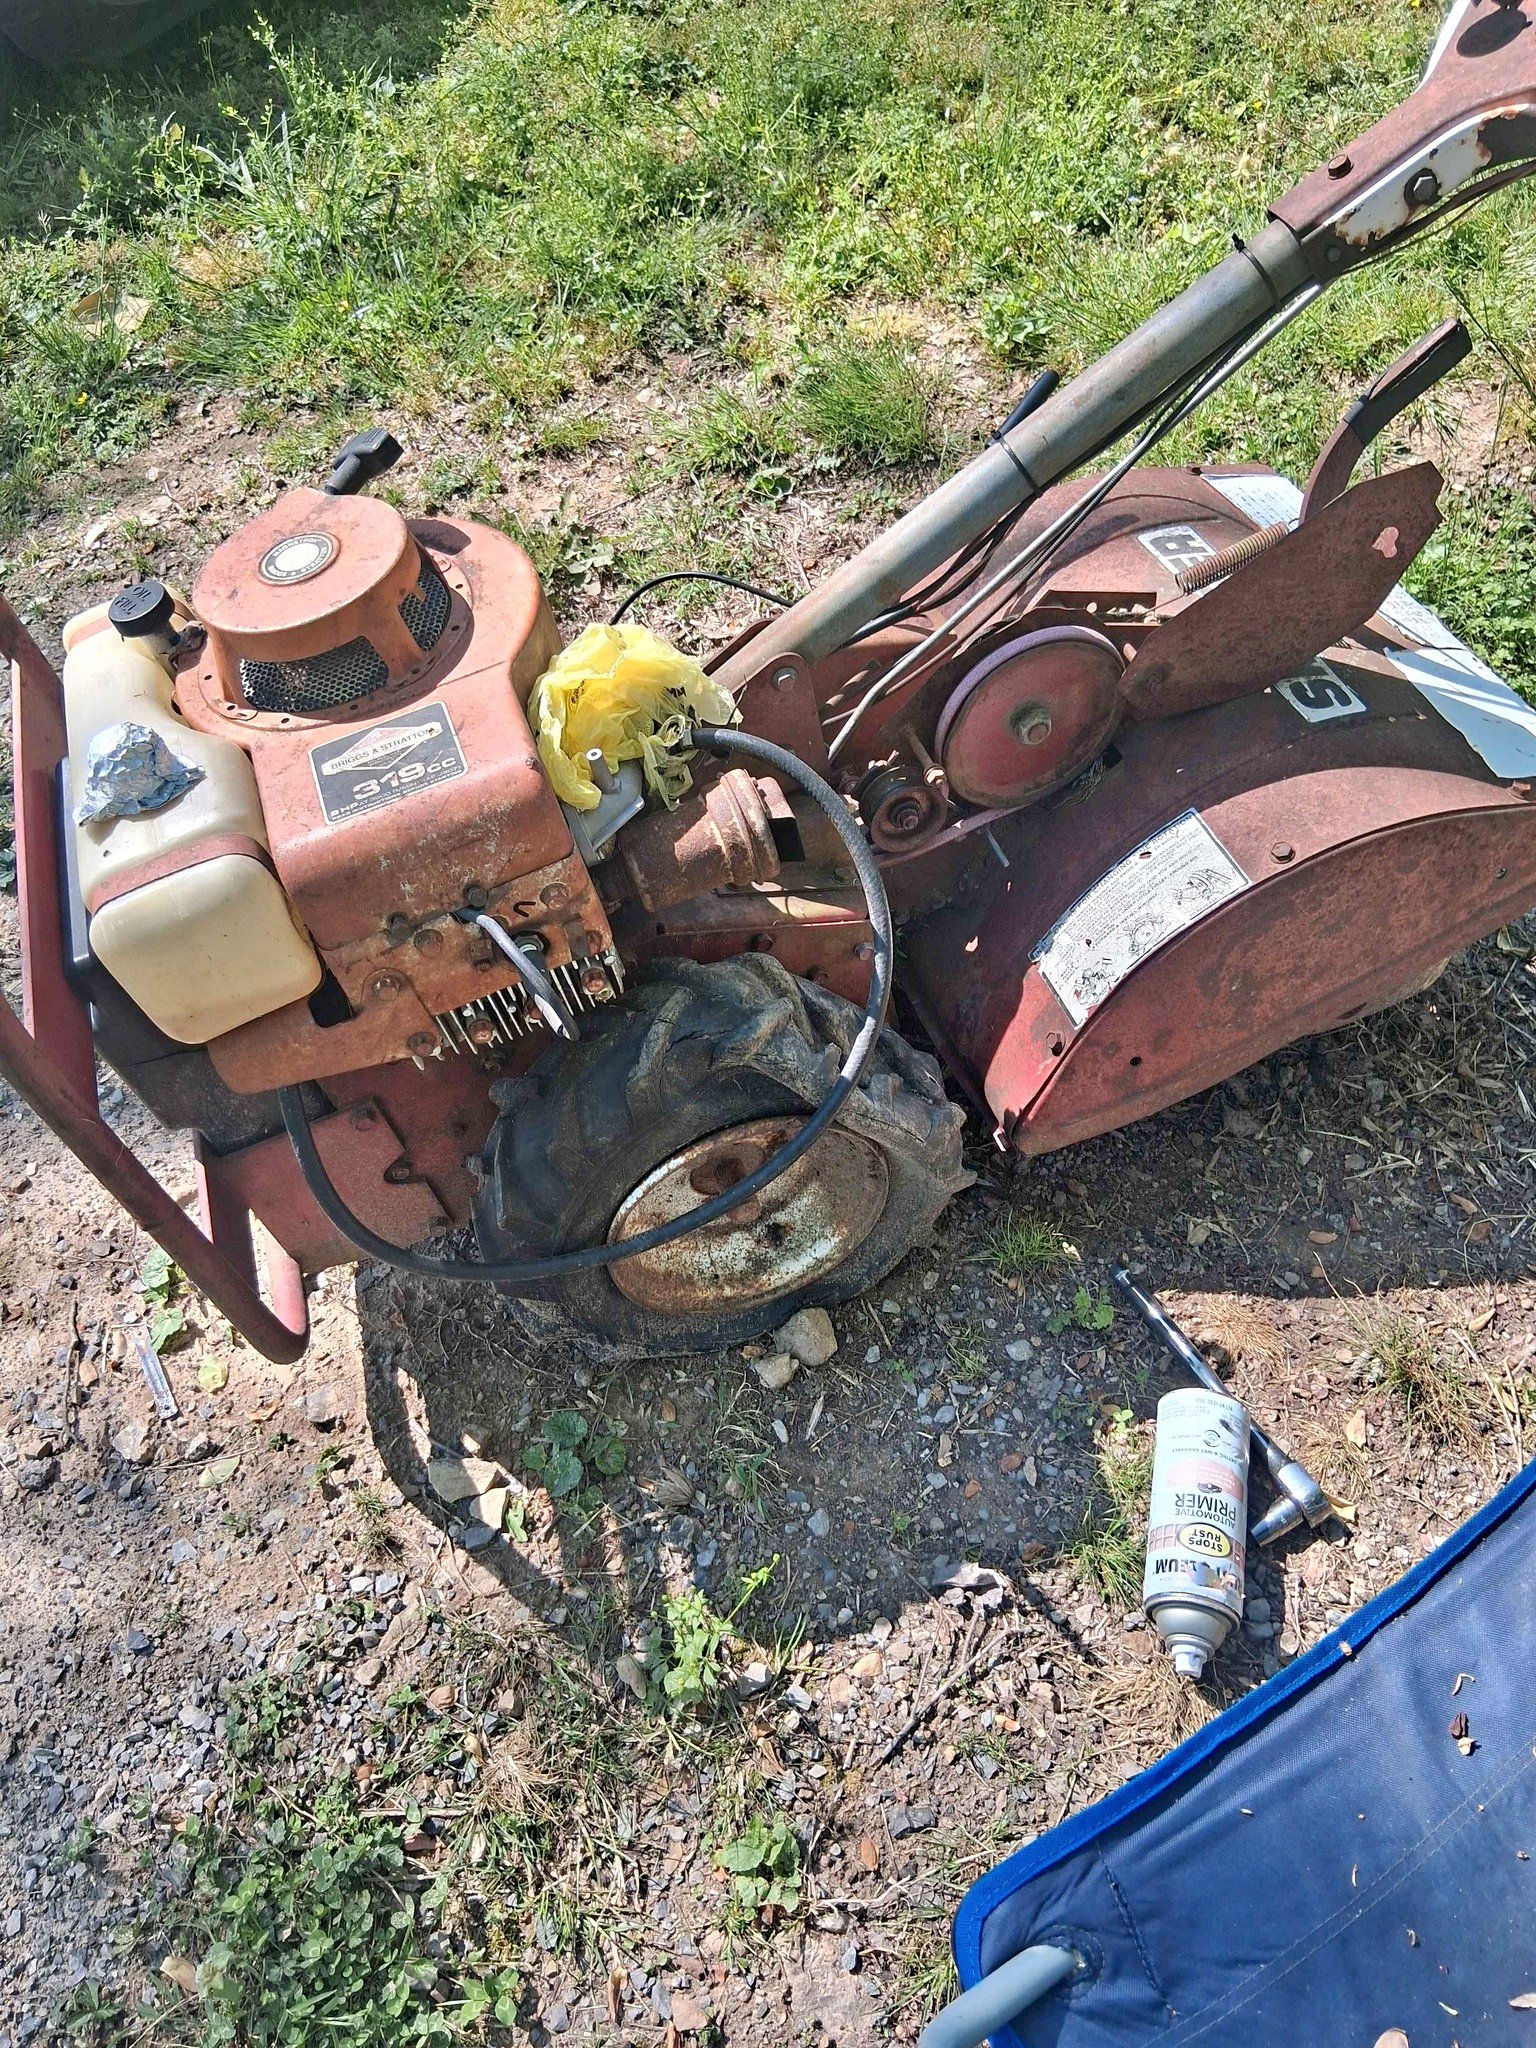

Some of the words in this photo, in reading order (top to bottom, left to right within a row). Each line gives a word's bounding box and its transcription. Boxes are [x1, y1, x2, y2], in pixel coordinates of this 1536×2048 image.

[132, 586, 152, 602] OIL
[114, 595, 136, 615] FILL
[330, 750, 369, 770] BRIGGS
[370, 746, 381, 754] &
[380, 726, 435, 751] STRATTON
[1173, 1492, 1236, 1519] PRIMER
[1174, 1507, 1235, 1528] AUTOMOTIVE
[1187, 1536, 1223, 1552] STOPS
[1190, 1527, 1221, 1542] RUST
